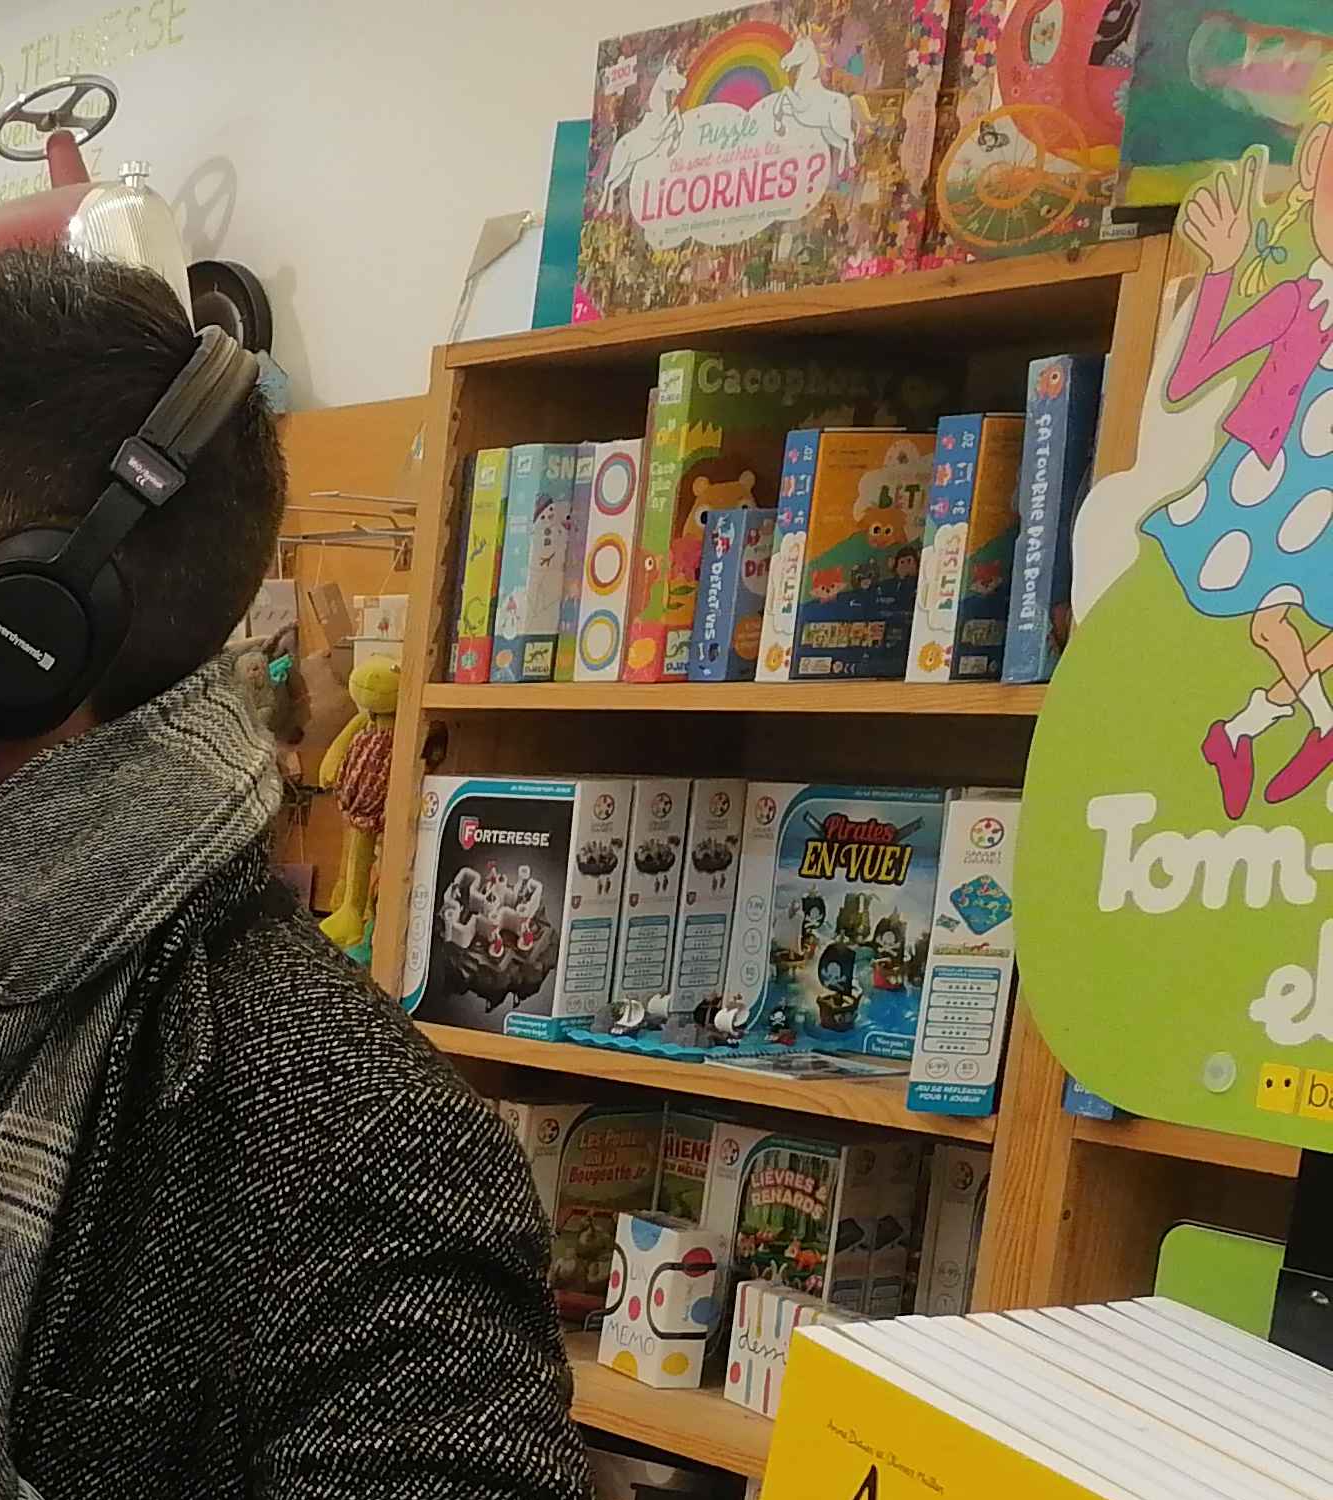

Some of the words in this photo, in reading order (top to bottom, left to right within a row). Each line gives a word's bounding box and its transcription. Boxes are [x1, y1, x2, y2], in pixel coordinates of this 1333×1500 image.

[698, 115, 758, 151] Puzzle
[463, 820, 550, 848] FORTERESSE
[1087, 792, 1333, 914] Tom-
[799, 840, 836, 880] EN
[751, 1188, 824, 1219] RENARDS
[605, 1317, 655, 1357] MEMO
